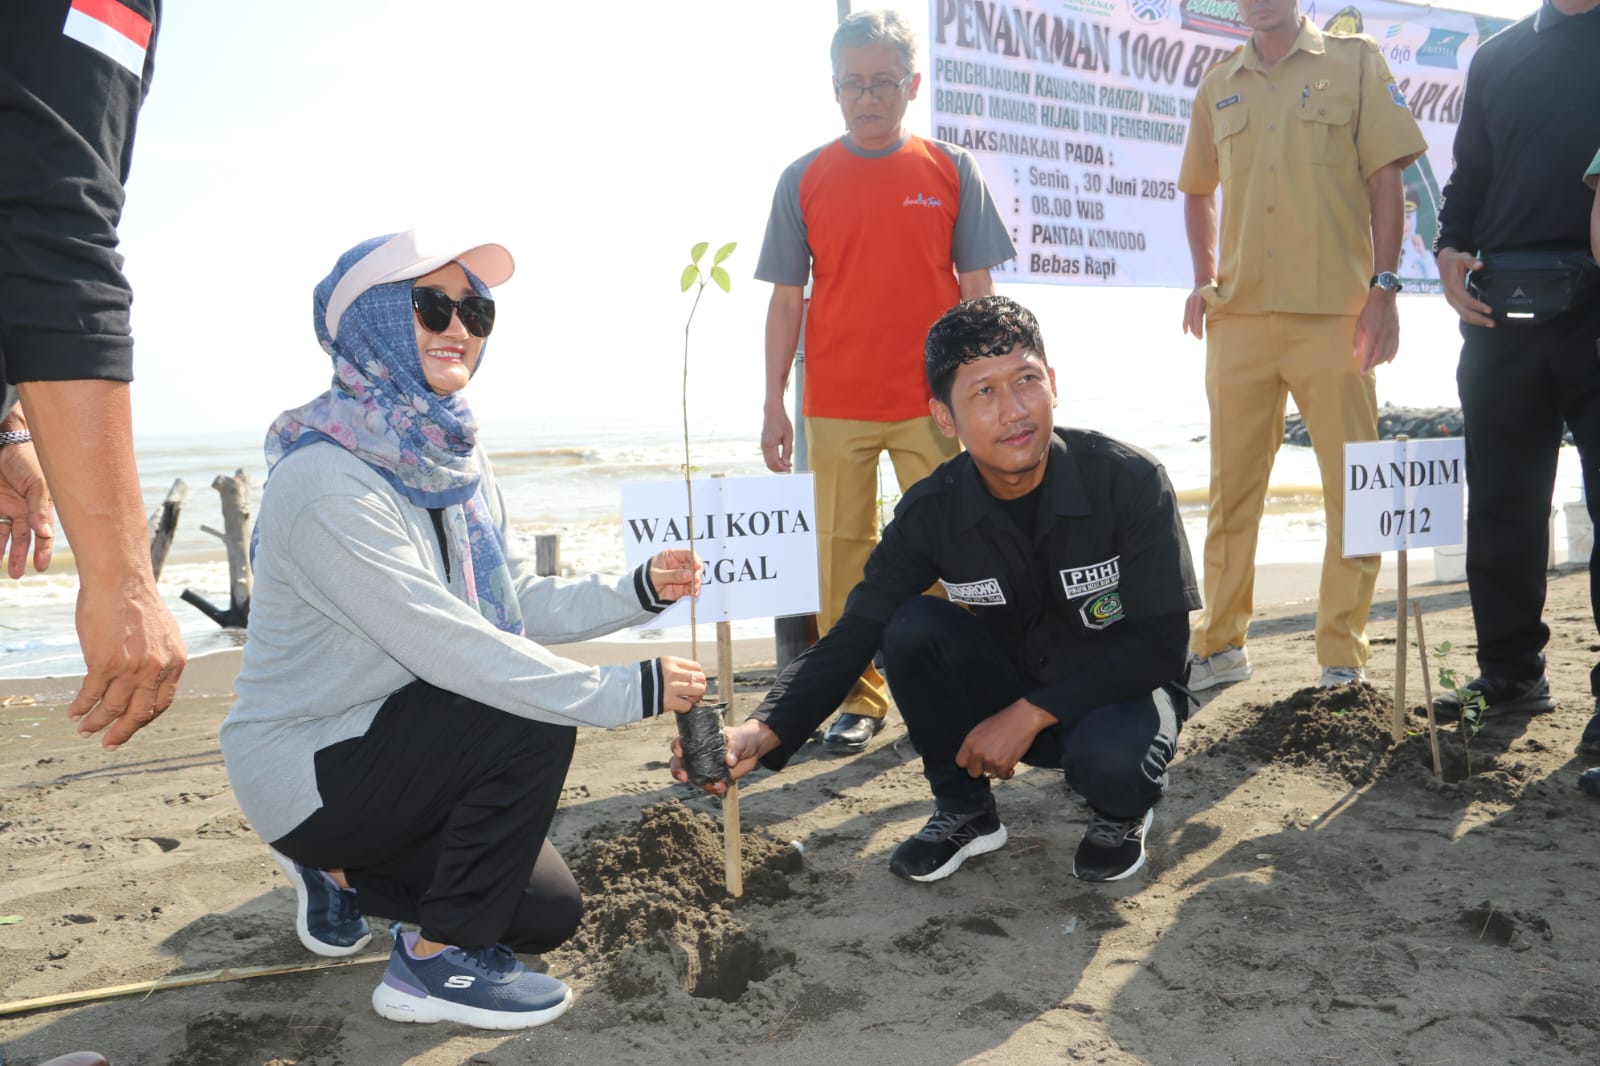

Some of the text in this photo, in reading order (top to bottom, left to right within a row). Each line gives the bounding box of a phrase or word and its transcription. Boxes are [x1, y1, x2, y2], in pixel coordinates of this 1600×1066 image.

[936, 0, 1110, 73] PENANAMAN
[1118, 29, 1184, 84] 1000
[936, 58, 1031, 95] PENGHIJAUAN
[1035, 74, 1096, 105] KAWASAN
[1100, 86, 1145, 113] PANTAI
[1147, 92, 1177, 117] YANG
[936, 89, 1186, 145] BRAVO MAWAR HIJAU DAN PEMERINTAH
[936, 126, 1060, 160] DILAKSANAKAN
[1065, 142, 1105, 166] PADA
[1029, 165, 1069, 189] Senin
[1083, 172, 1101, 193] 30
[1106, 176, 1137, 197] Juni
[1141, 179, 1176, 200] 2025
[1031, 195, 1072, 218] 08.00
[1077, 199, 1105, 221] WIB
[1031, 224, 1083, 247] PANTAI
[1088, 228, 1147, 251] KOMODO
[1030, 253, 1080, 276] Bebas
[1085, 257, 1116, 280] Rapi
[1350, 459, 1460, 491] DANDIM
[628, 509, 811, 544] WALI KOTA
[1380, 507, 1431, 537] 0712
[700, 556, 778, 586] EGAL
